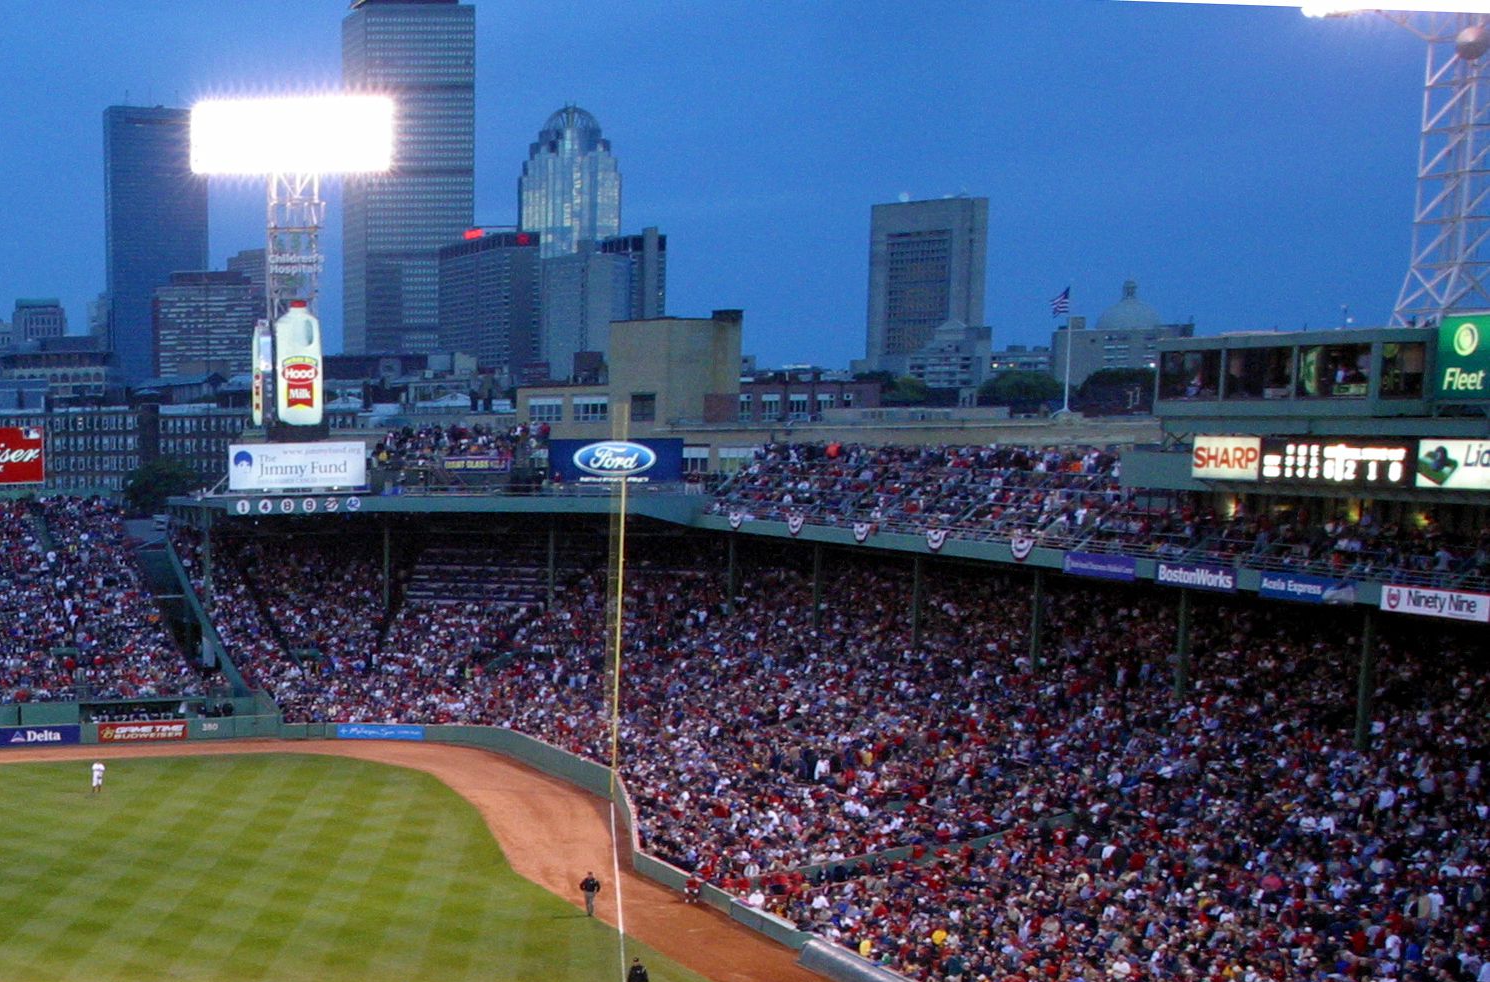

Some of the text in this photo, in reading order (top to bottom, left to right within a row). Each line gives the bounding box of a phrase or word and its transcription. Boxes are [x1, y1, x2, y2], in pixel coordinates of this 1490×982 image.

[284, 365, 315, 379] Hood
[1442, 367, 1486, 391] Fleet
[289, 388, 311, 400] Milk
[259, 454, 276, 463] The
[590, 446, 638, 469] Ford
[1193, 446, 1258, 469] SHARP
[258, 461, 347, 477] Jimmy Fund
[1158, 564, 1233, 589] BostonWorks
[1261, 578, 1322, 595] Acela Express
[1407, 590, 1477, 613] Ninety Nine
[26, 730, 61, 742] Delta
[113, 731, 183, 740] BUDWEISER
